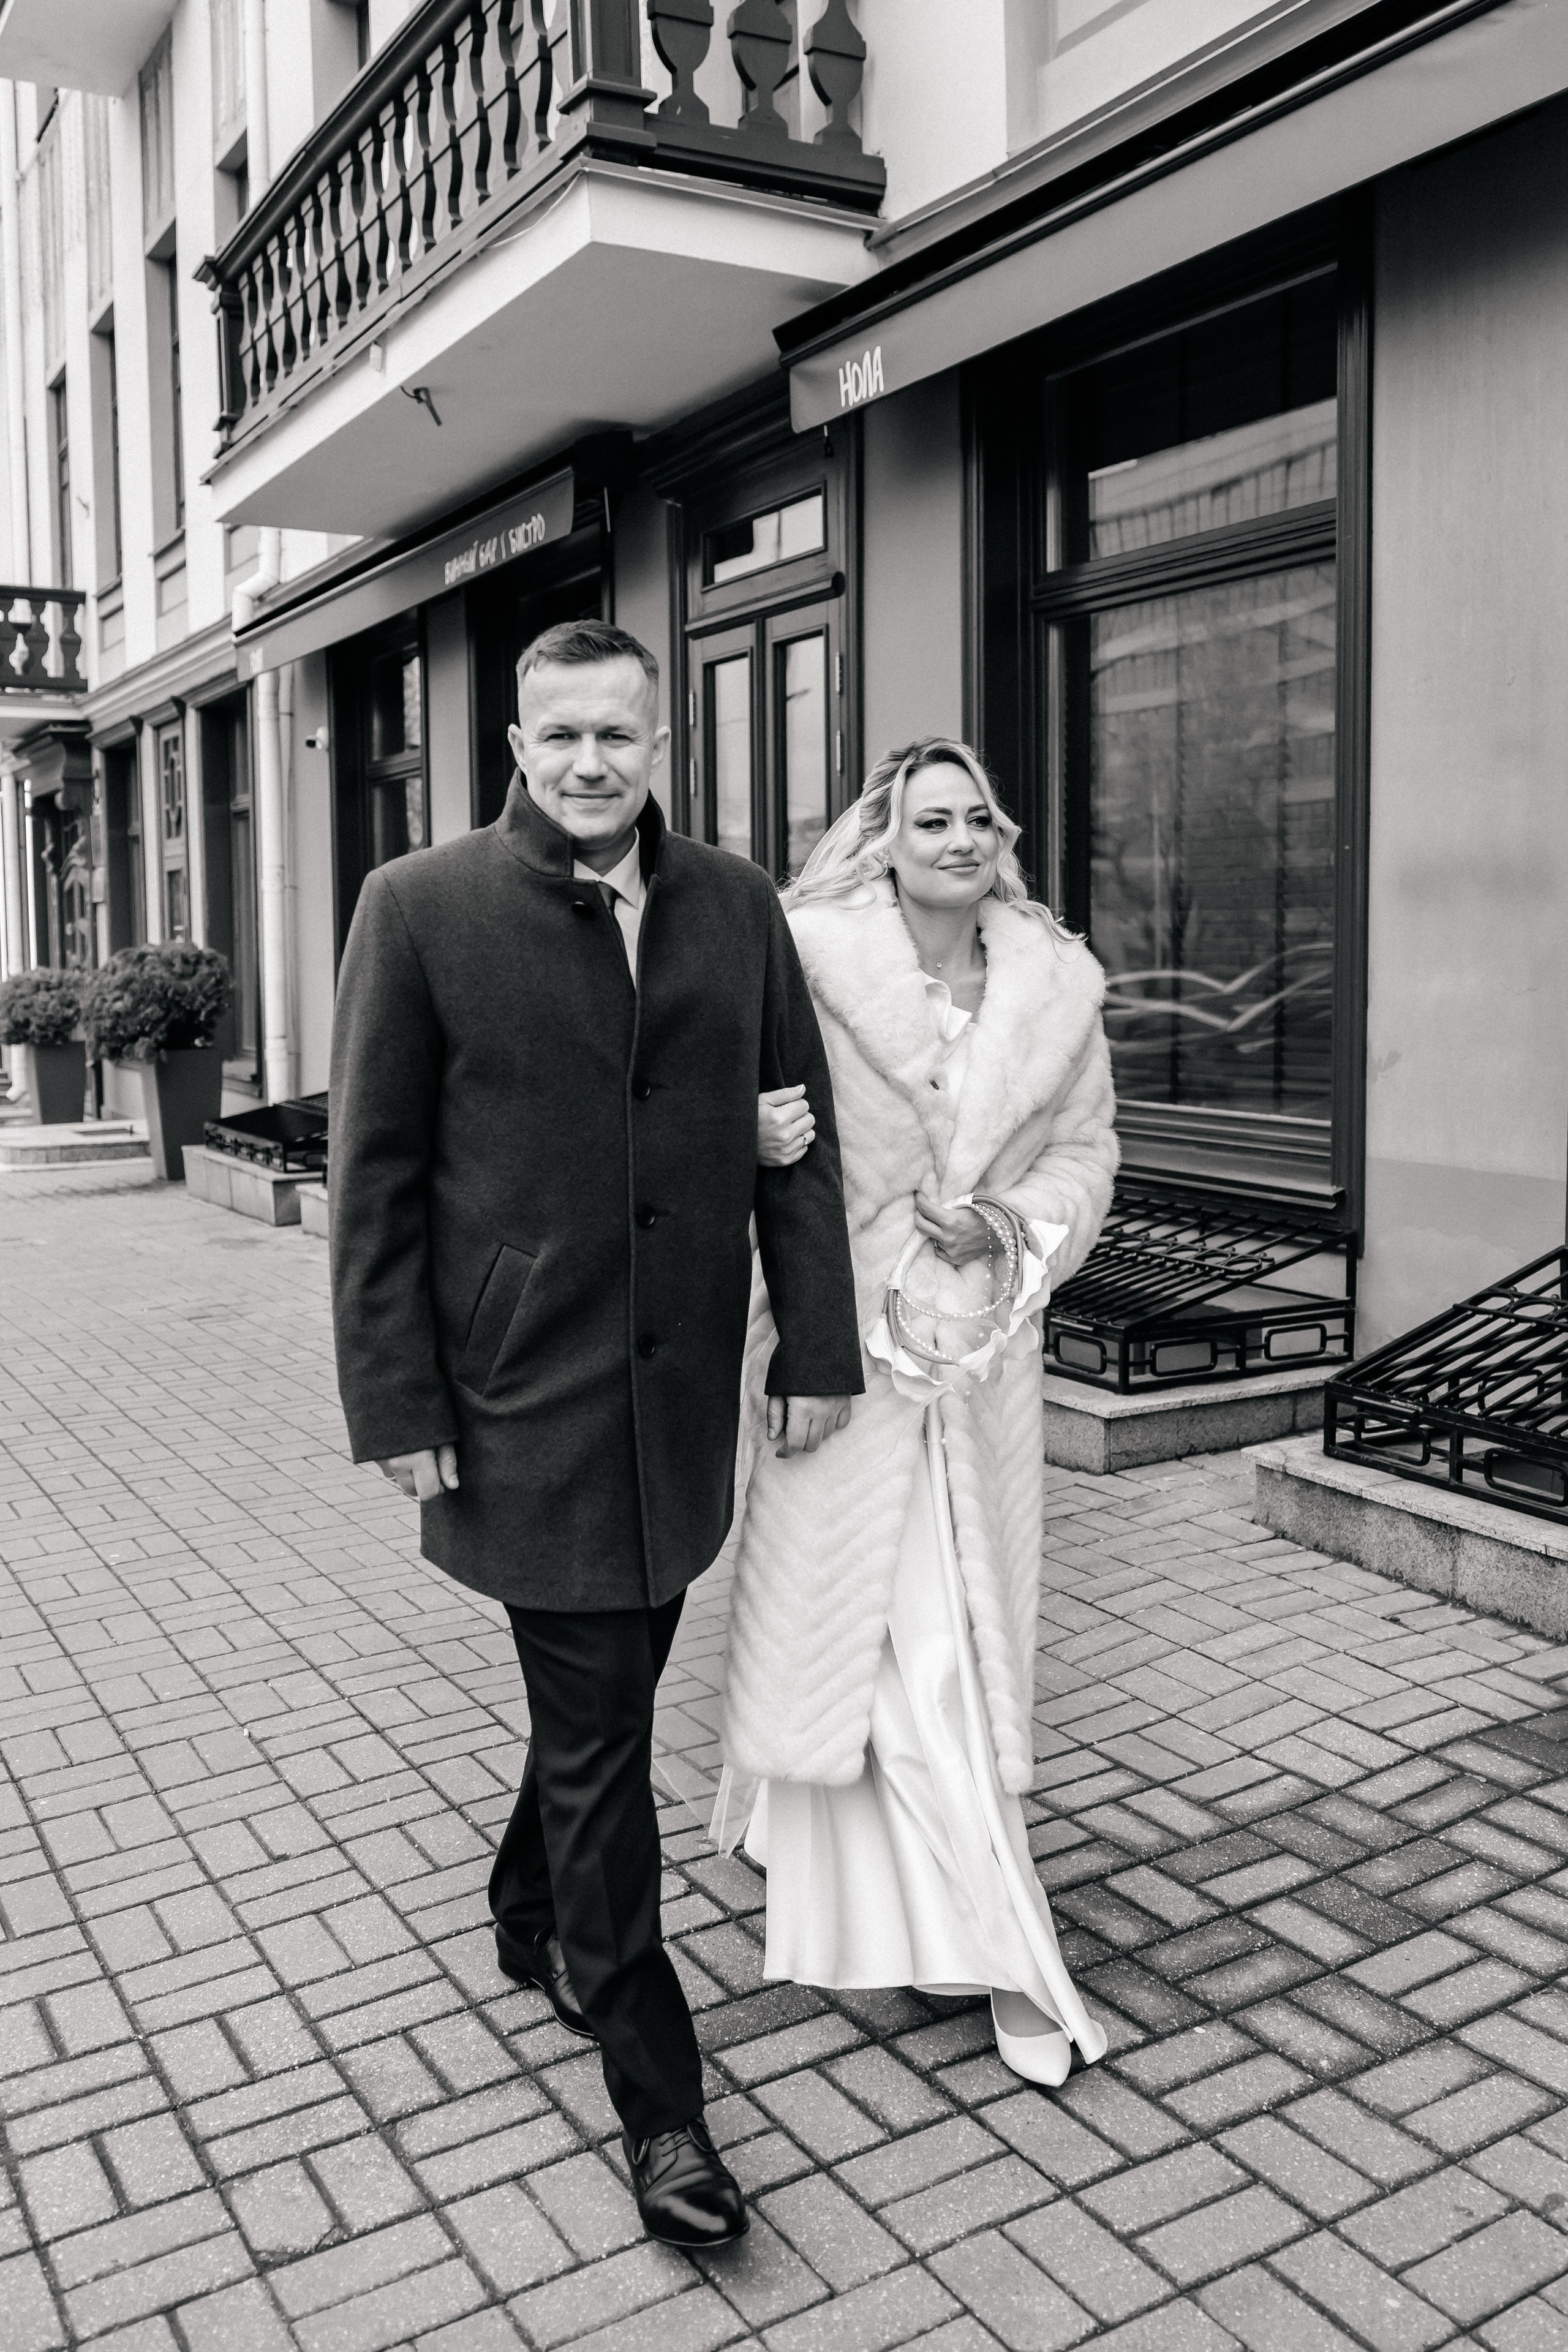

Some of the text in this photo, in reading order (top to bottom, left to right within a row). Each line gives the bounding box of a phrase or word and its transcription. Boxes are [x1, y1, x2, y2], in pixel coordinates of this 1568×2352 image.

[839, 345, 884, 408] НОЛА
[479, 537, 497, 568] БАР
[508, 513, 545, 554] БИСТРО
